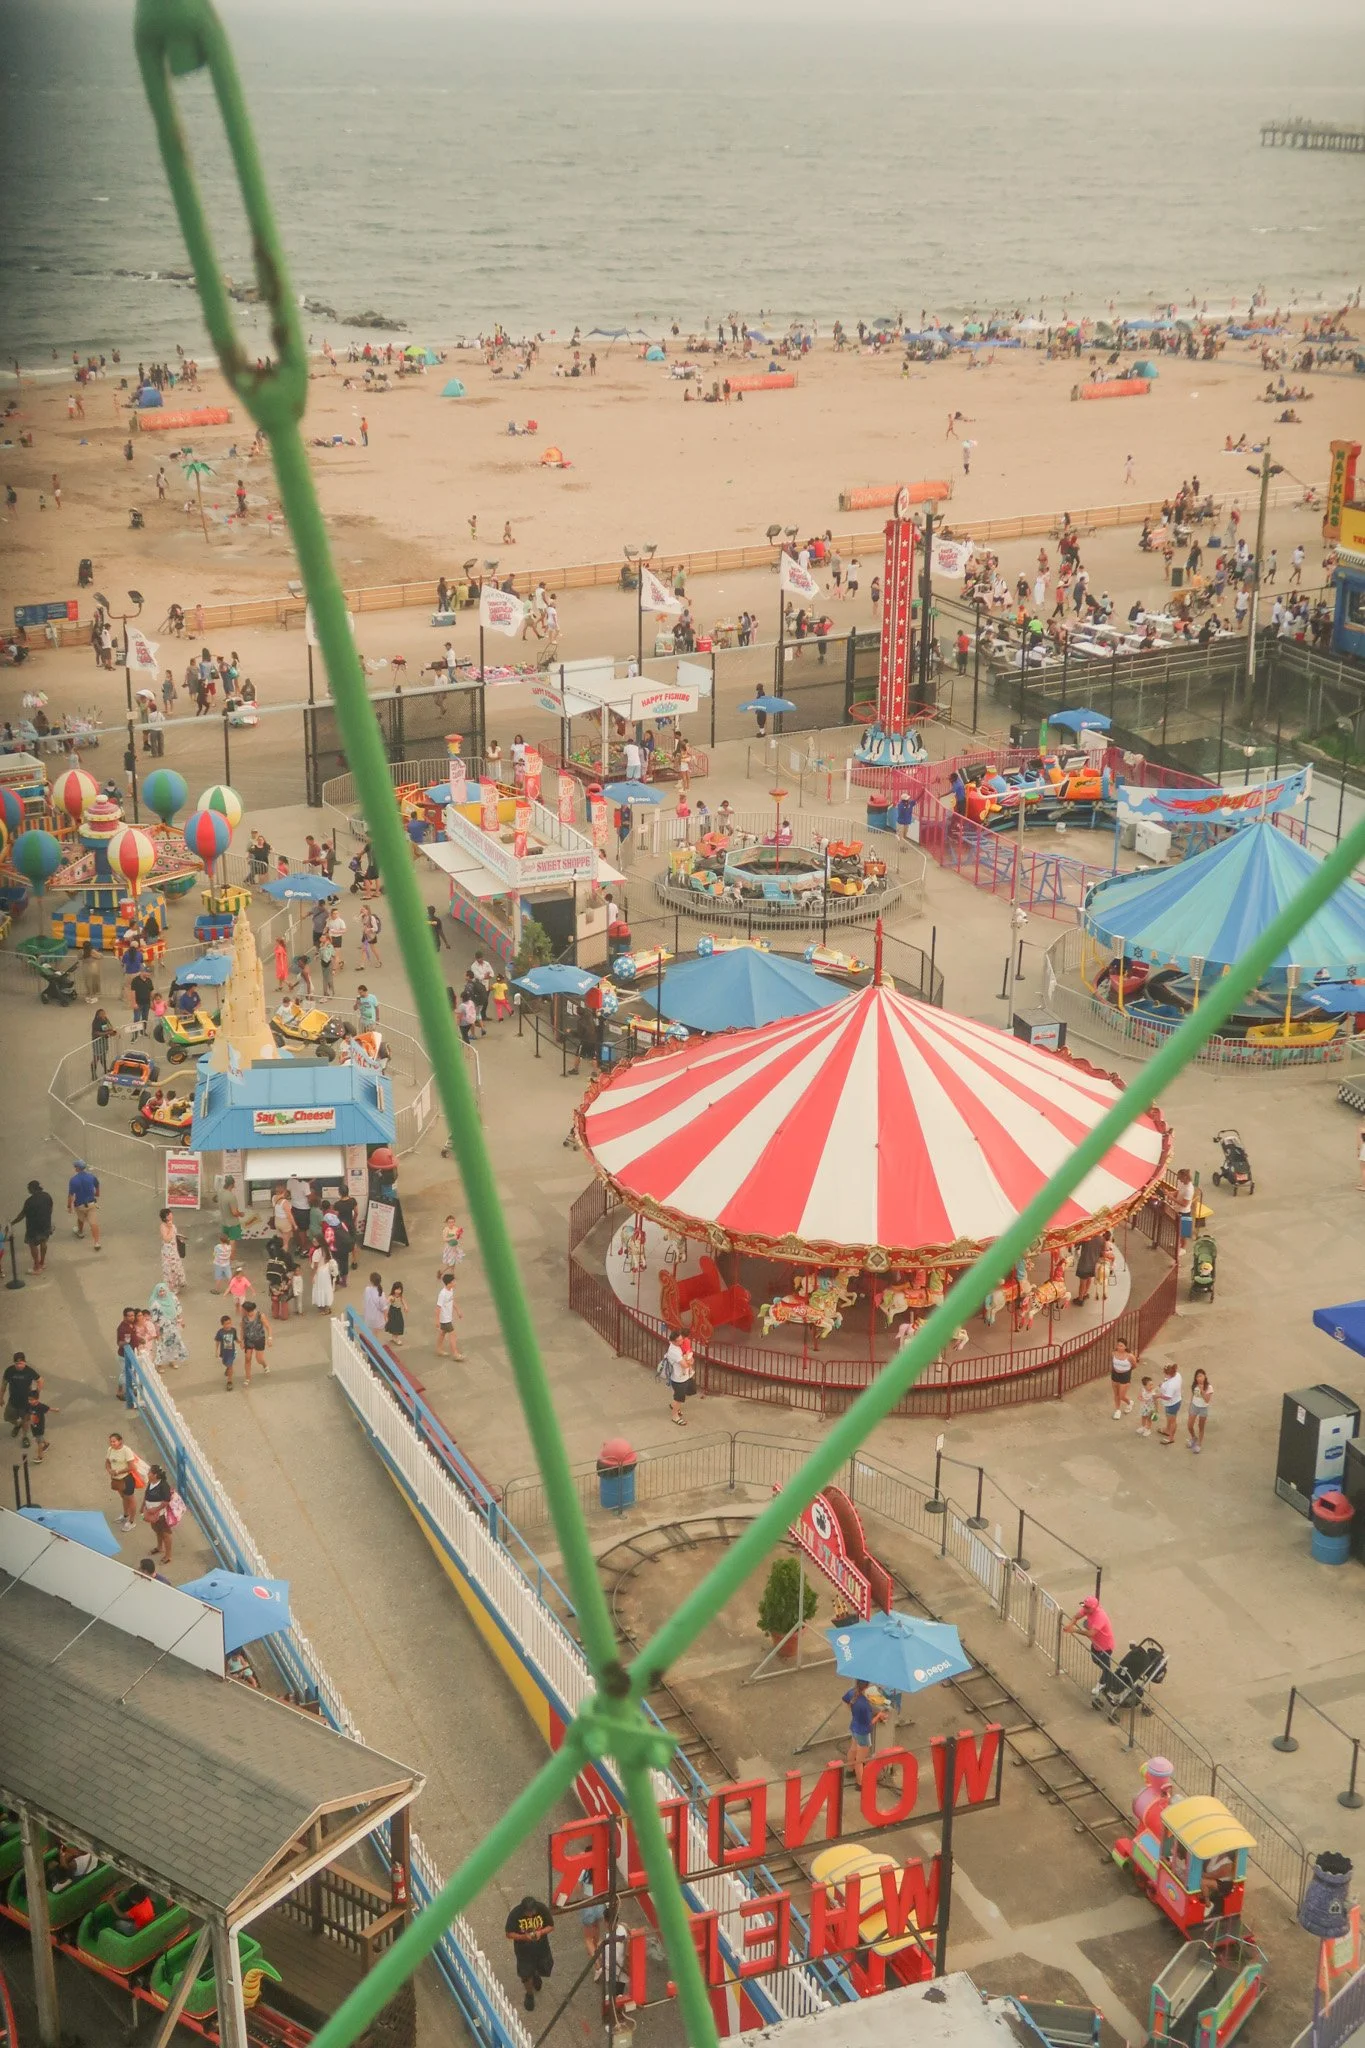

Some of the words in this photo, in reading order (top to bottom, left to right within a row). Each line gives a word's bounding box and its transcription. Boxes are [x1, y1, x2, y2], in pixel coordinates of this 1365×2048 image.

[641, 693, 664, 708] HAPPY
[664, 692, 691, 703] FISHING
[536, 859, 561, 873] SWEET
[562, 856, 591, 870] SHOPPE
[255, 1112, 276, 1125] Say
[293, 1109, 334, 1121] Cheese!
[817, 1540, 862, 1603] STATION
[926, 1659, 953, 1678] pepsi
